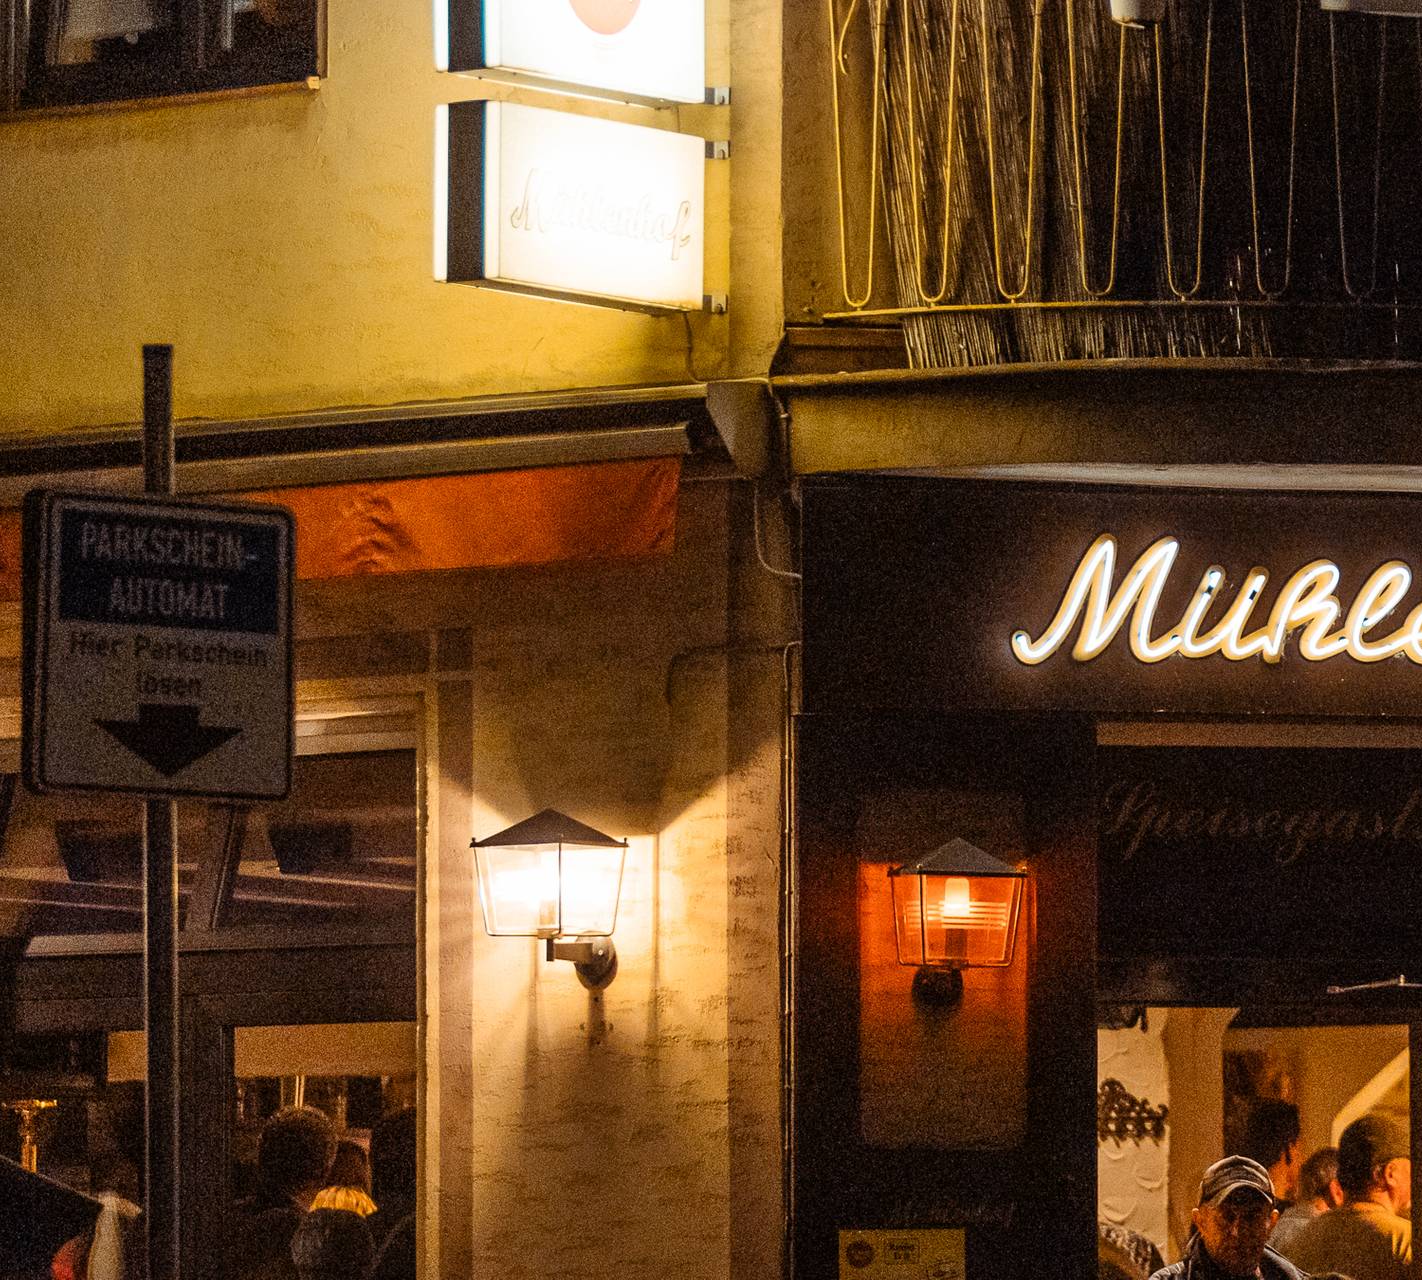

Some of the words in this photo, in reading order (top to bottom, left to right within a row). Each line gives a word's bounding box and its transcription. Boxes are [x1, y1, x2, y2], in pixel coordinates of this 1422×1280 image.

[81, 521, 258, 570] PARKSCHEIN-
[109, 576, 229, 620] AUTOMAT
[70, 632, 123, 658] Hier
[134, 635, 268, 668] Parkschein
